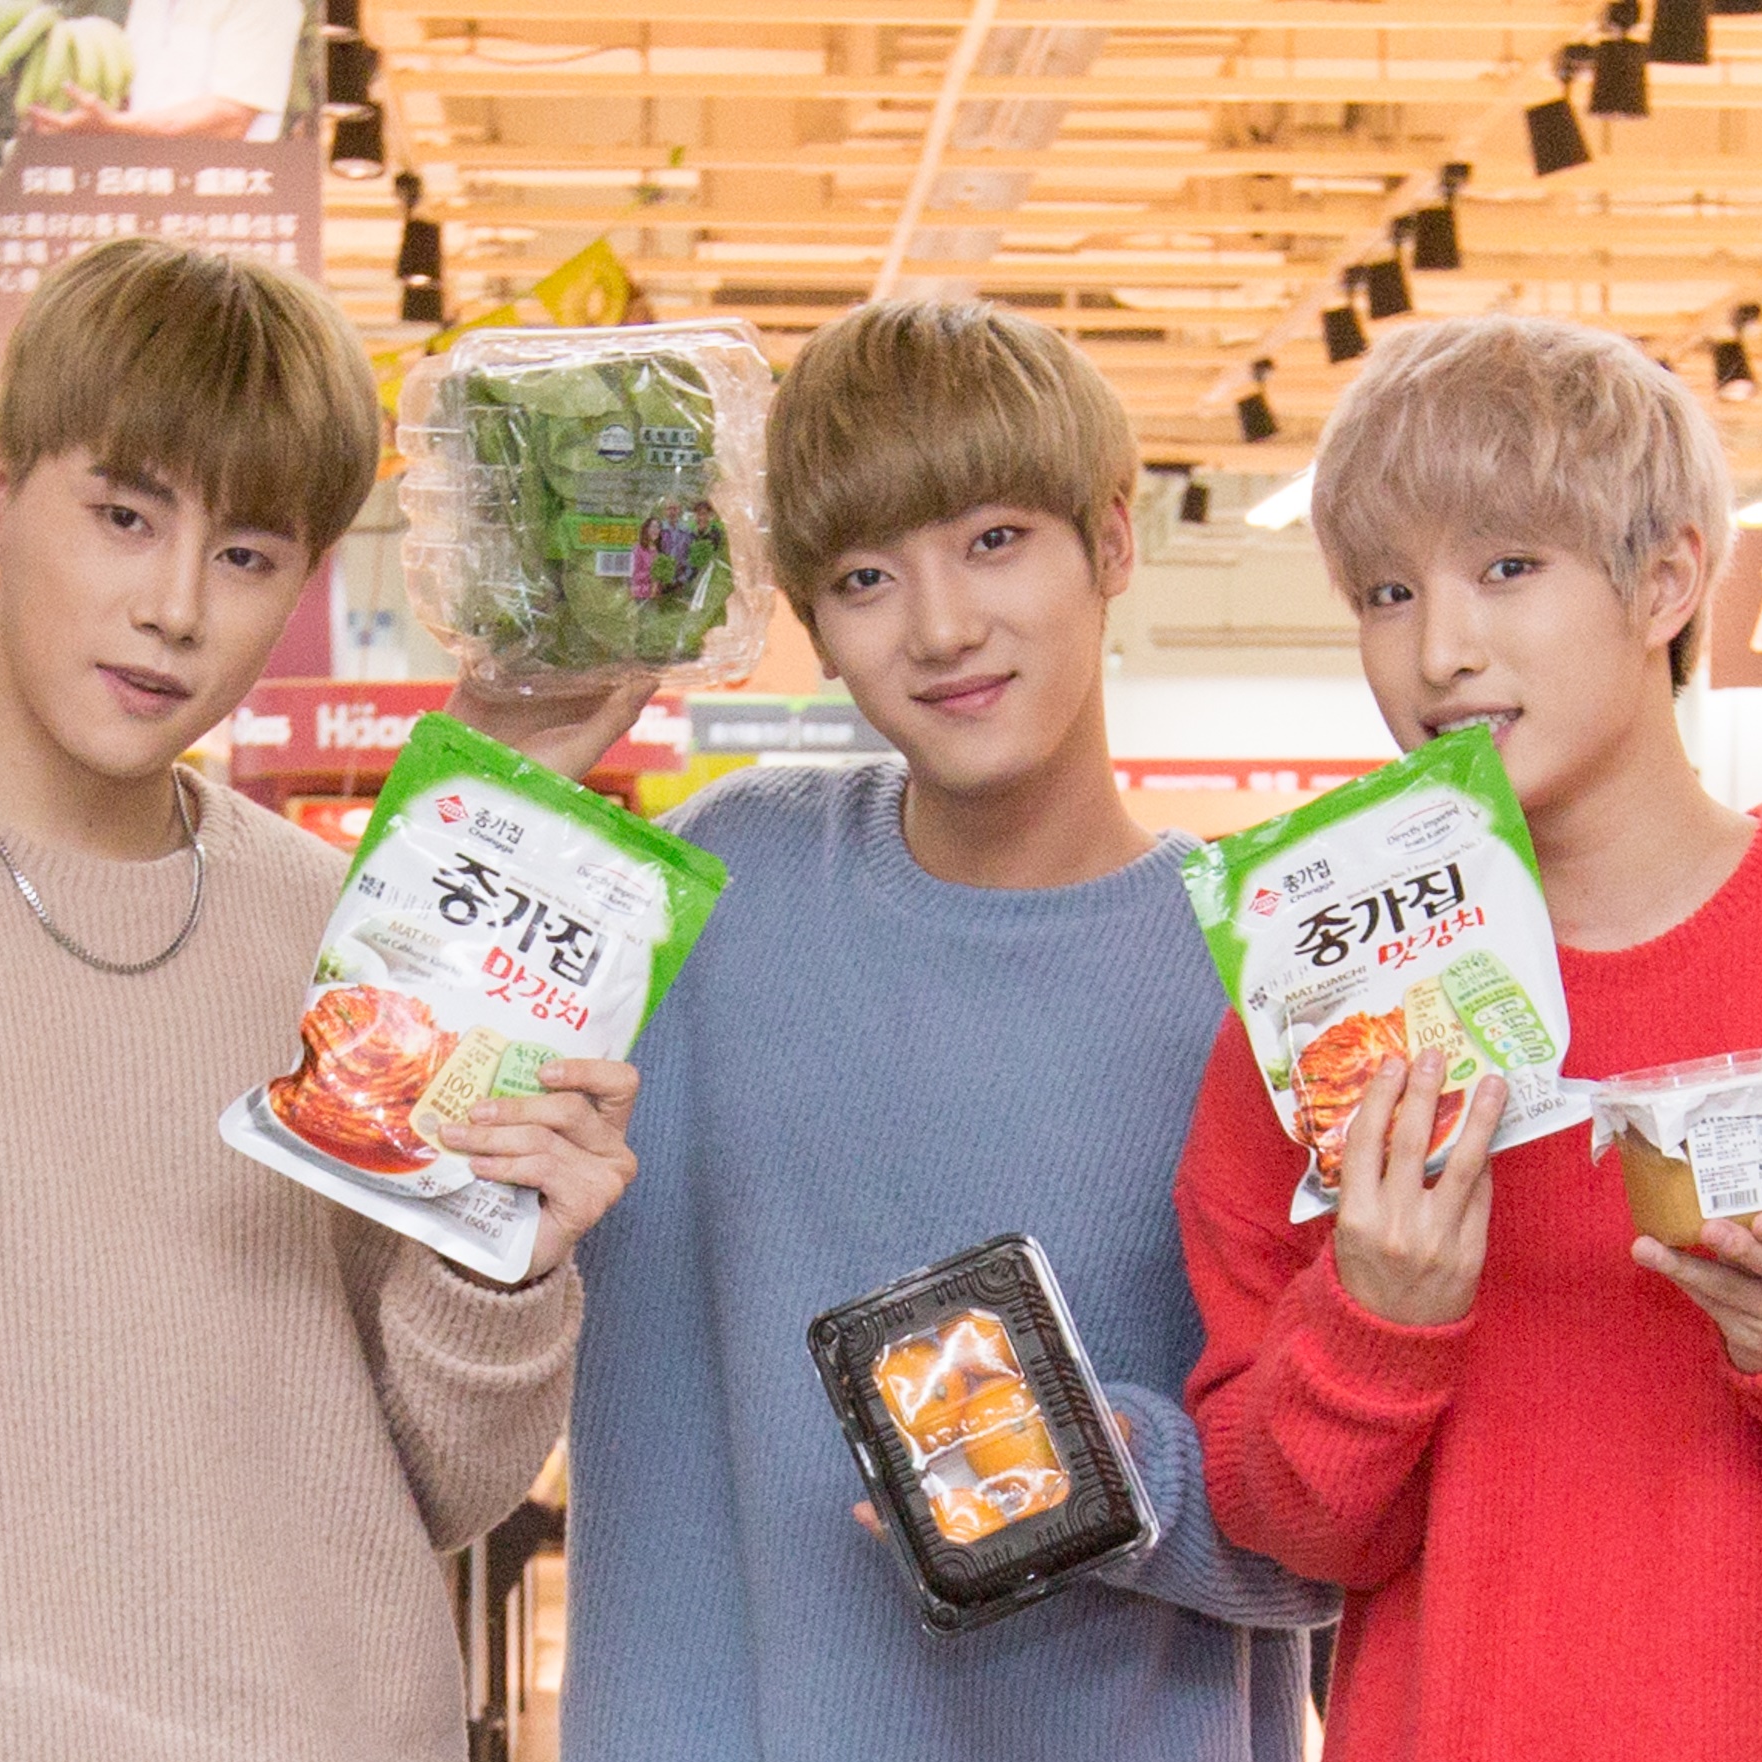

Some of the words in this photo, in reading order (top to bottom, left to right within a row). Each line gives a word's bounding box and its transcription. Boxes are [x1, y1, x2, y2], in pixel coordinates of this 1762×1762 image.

[474, 806, 525, 845] 종가집
[1282, 858, 1332, 894] 종가집
[431, 852, 609, 987] 종가집
[1293, 862, 1467, 968] 종가집
[1377, 906, 1486, 971] 맛김치
[481, 946, 589, 1032] 맛김치
[1414, 1021, 1446, 1045] 100
